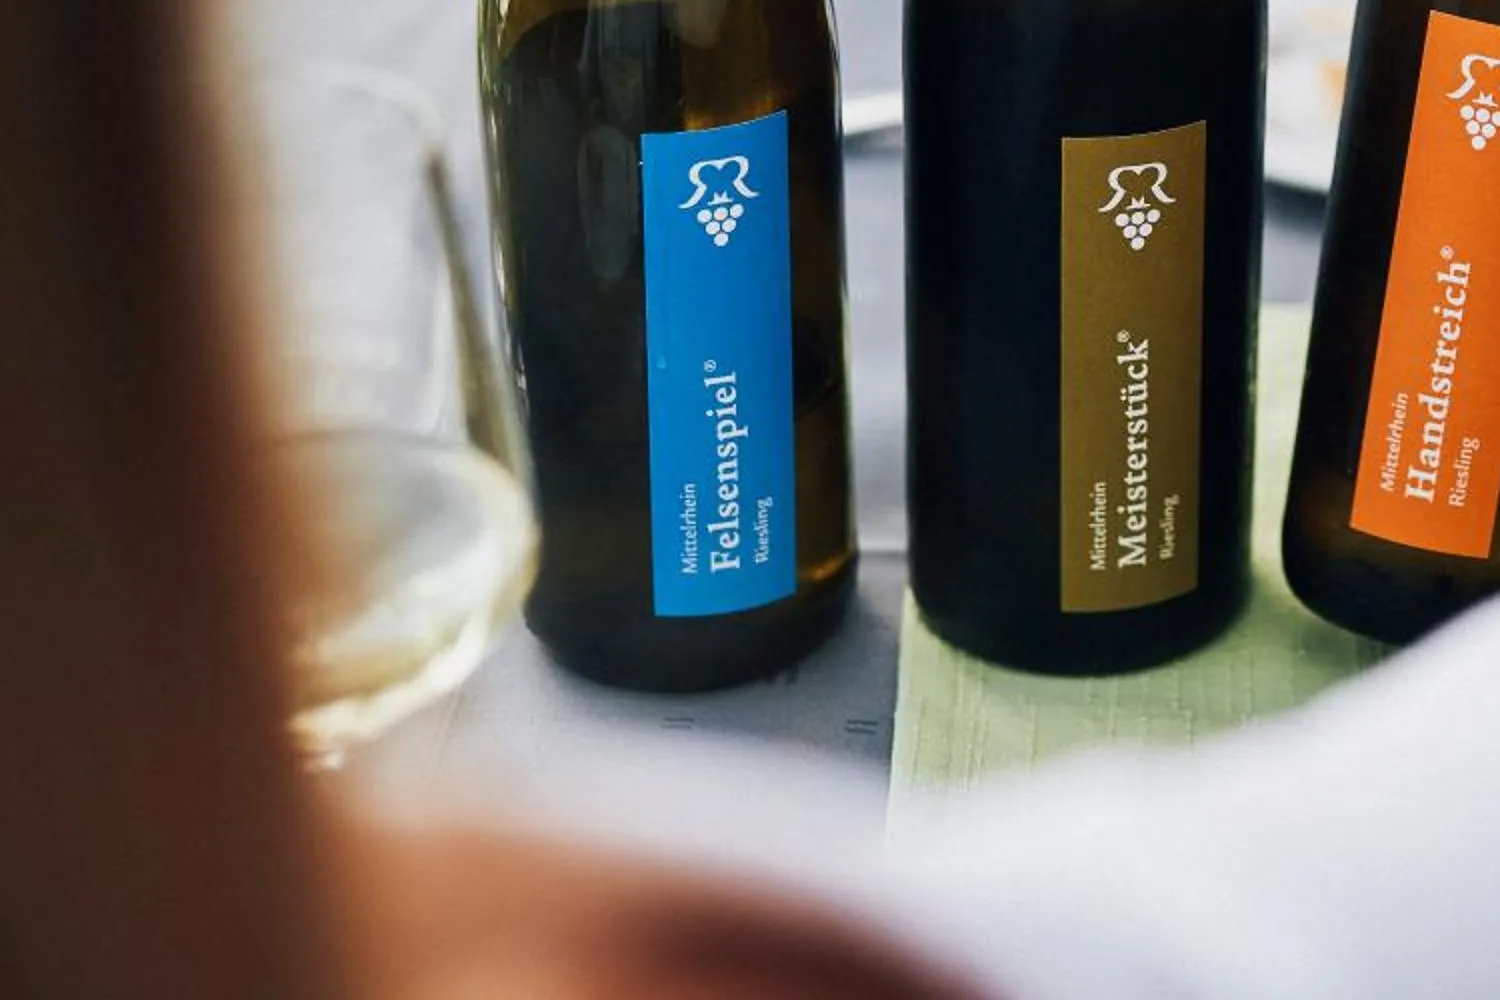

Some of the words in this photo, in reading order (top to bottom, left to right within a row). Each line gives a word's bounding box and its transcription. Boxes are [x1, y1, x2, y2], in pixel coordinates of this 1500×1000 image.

[1380, 392, 1409, 493] Mittelrhein
[1448, 436, 1480, 508] Riesling
[680, 483, 697, 575] Mittelrhein
[755, 496, 773, 565] Riesling
[1089, 481, 1107, 571] Mittelrhein
[1159, 494, 1180, 560] Riesling
